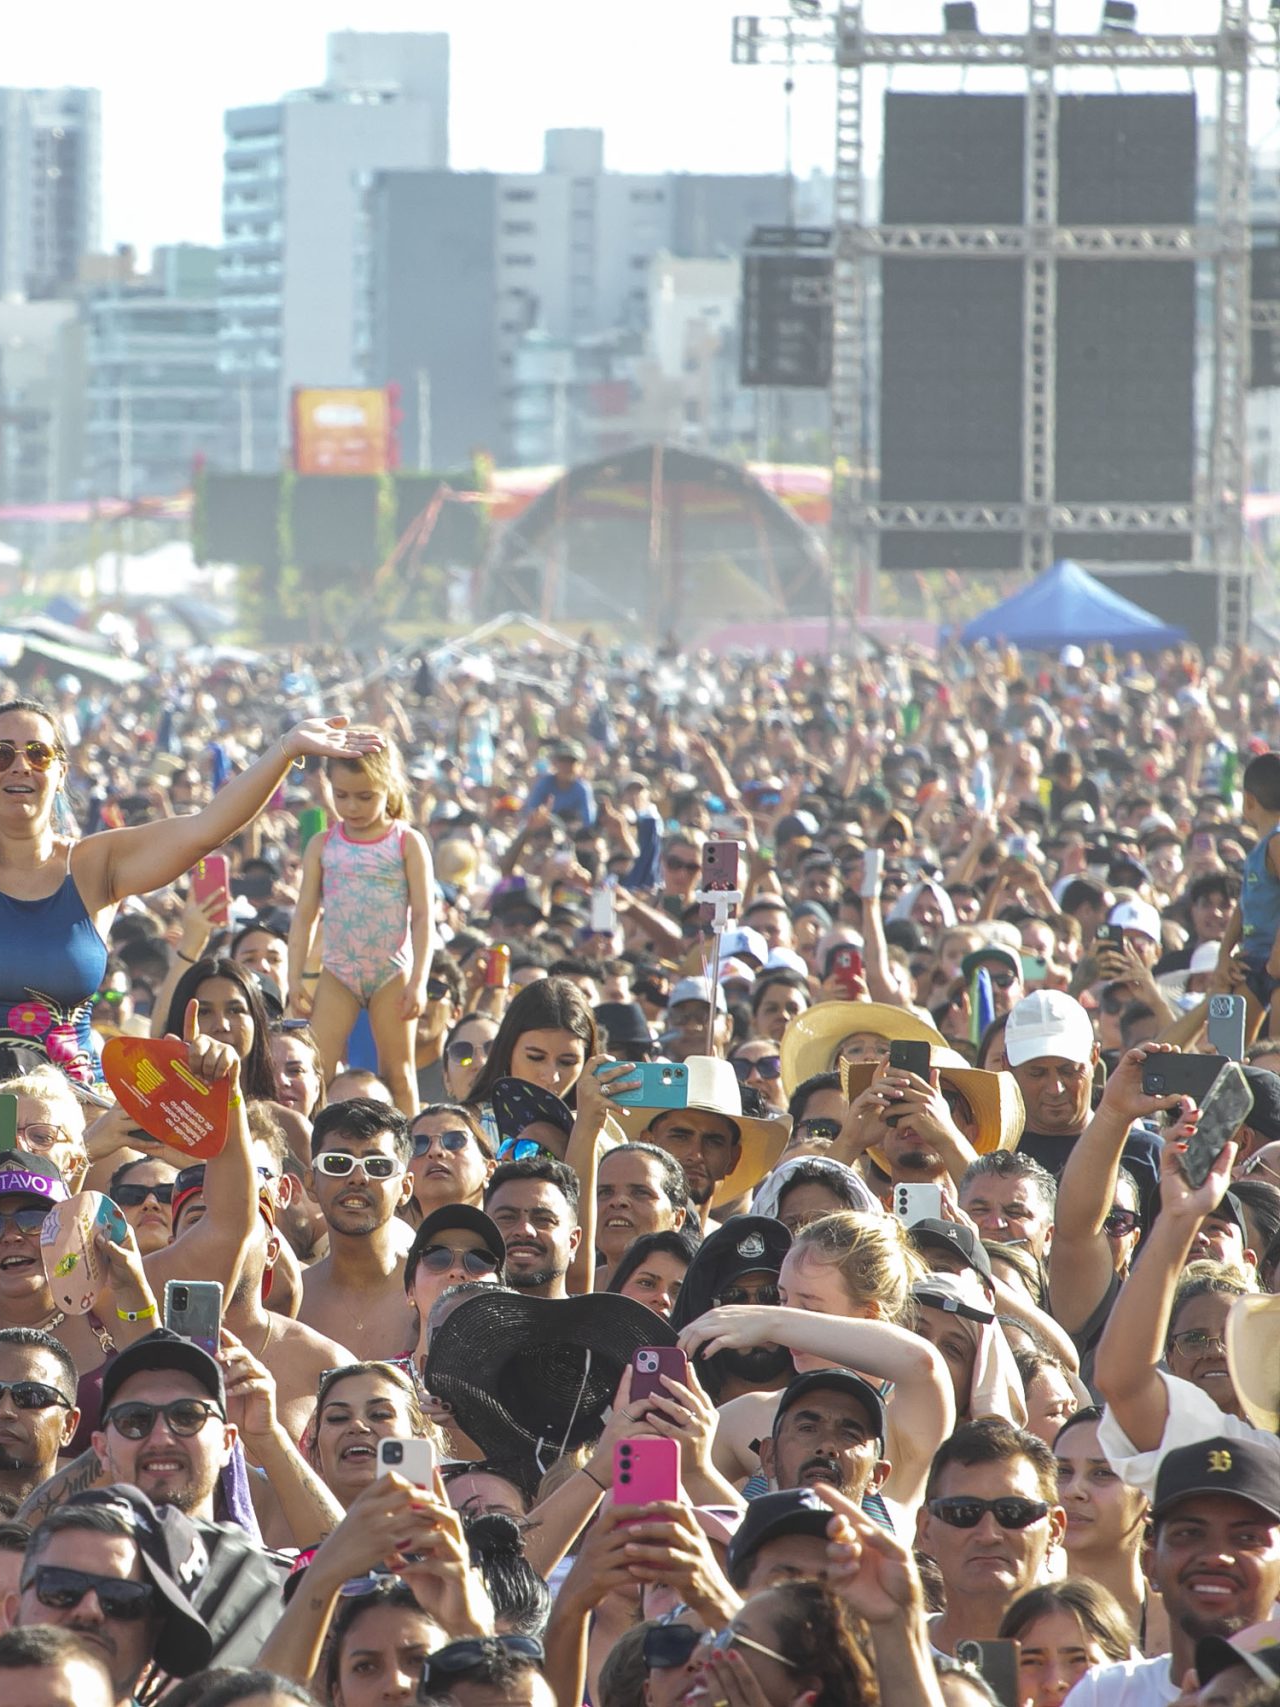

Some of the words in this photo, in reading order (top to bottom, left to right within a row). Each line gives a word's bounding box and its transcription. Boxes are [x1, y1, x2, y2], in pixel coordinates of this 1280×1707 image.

[160, 1102, 180, 1122] Centro
[181, 1100, 205, 1123] Curitiba
[165, 1118, 175, 1127] no
[180, 1121, 202, 1142] Melhor
[204, 1121, 214, 1131] de
